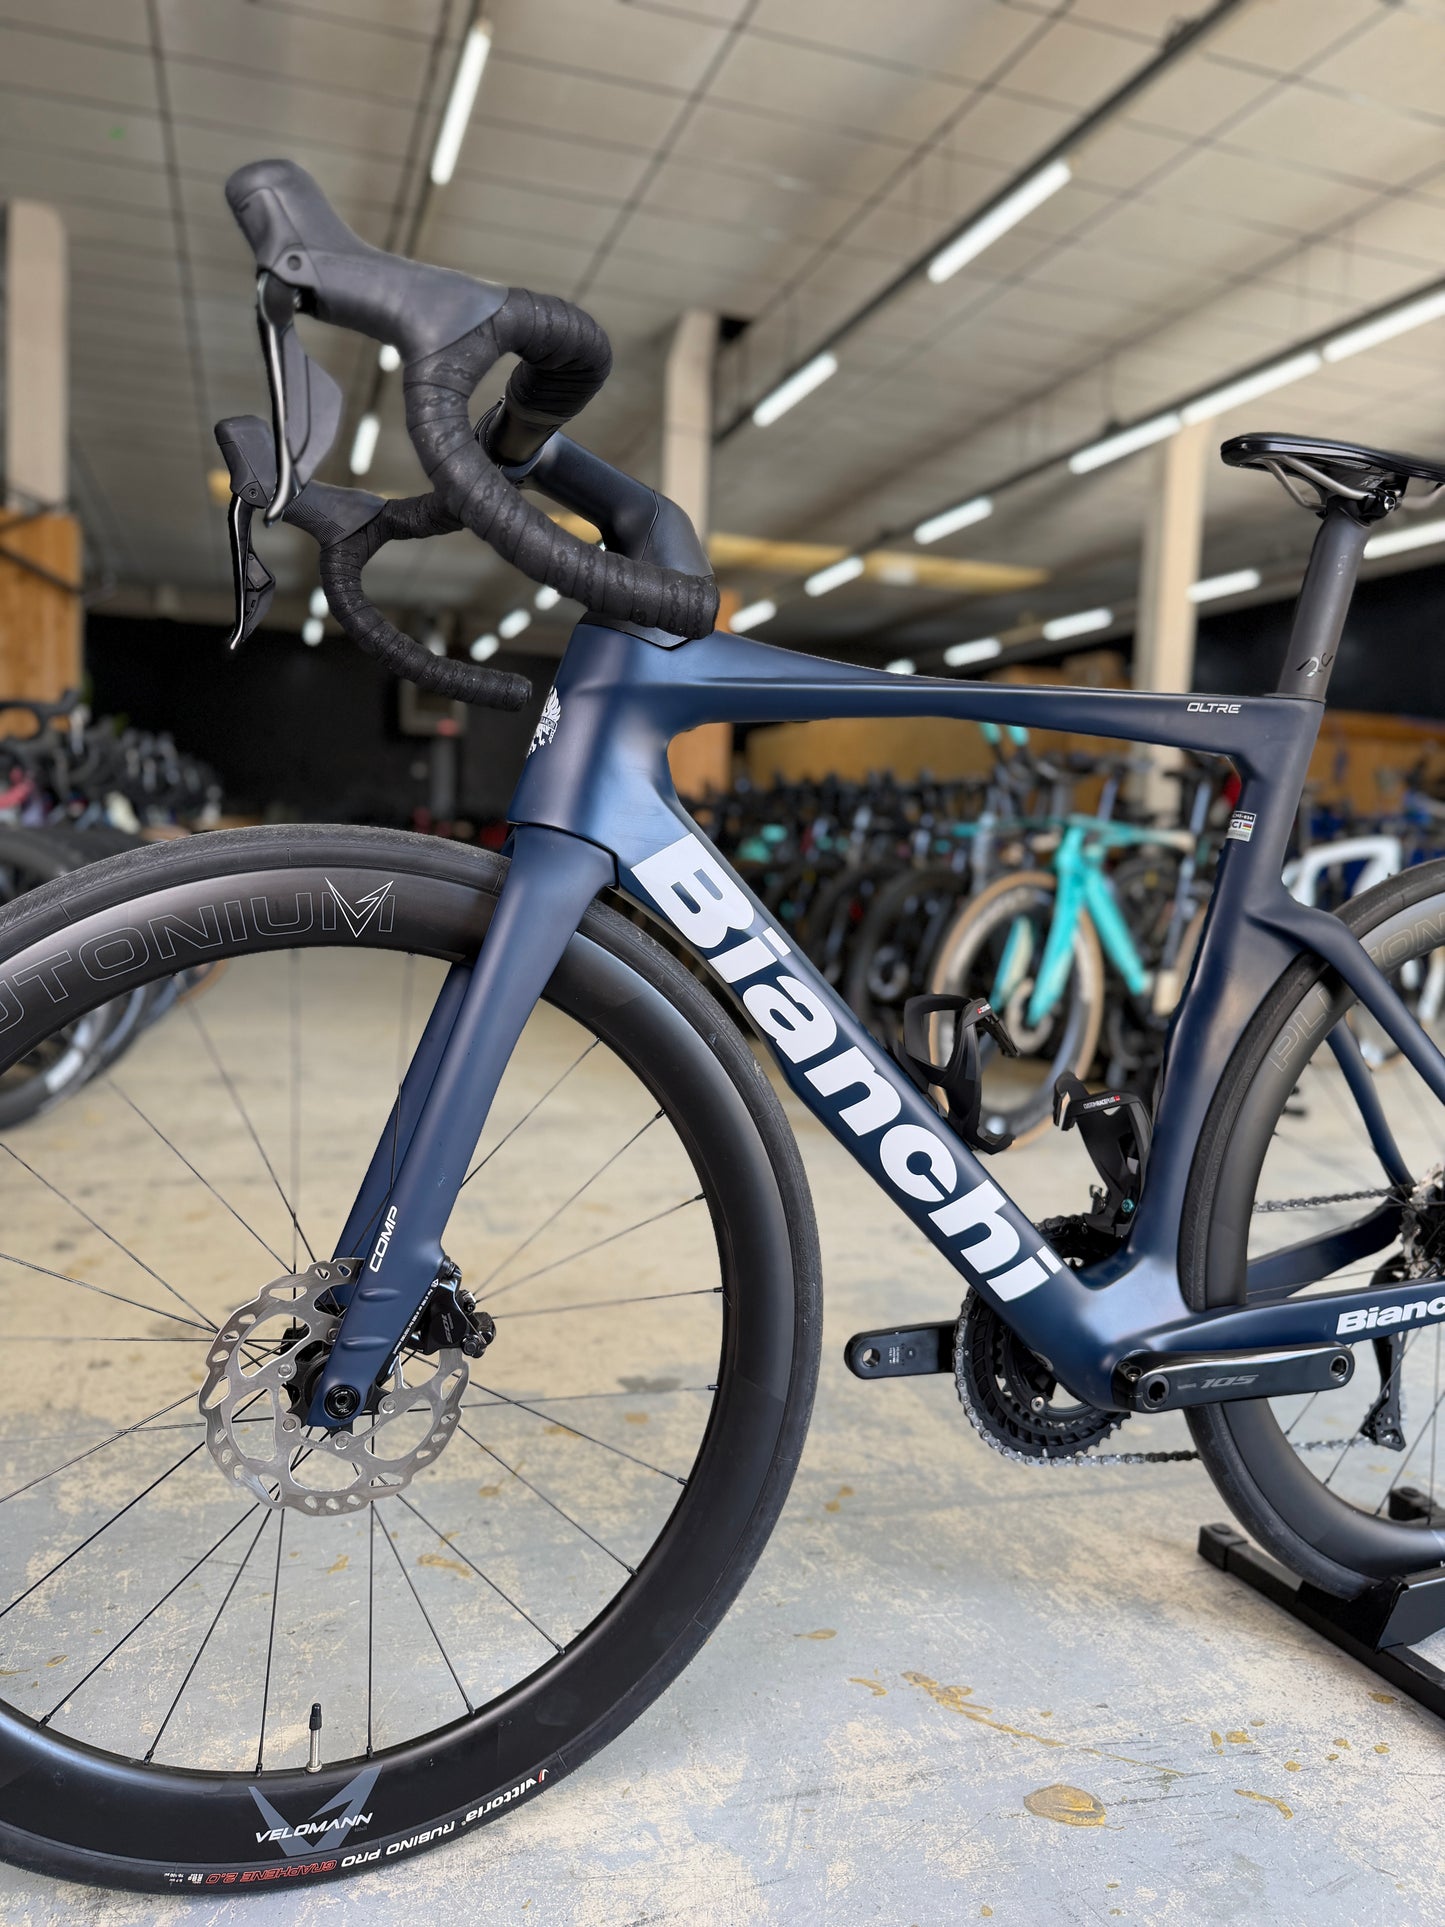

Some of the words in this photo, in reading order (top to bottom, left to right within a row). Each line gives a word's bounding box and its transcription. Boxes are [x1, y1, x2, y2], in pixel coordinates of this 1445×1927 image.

[1187, 702, 1242, 714] OLTRE
[631, 833, 1063, 1302] Bianchi
[369, 1205, 398, 1273] COMP
[1200, 1374, 1259, 1389] 105
[255, 1811, 374, 1844] VELOMANN
[386, 1821, 456, 1855] RUBINO
[341, 1848, 382, 1868] PRO
[205, 1870, 237, 1885] 2.0
[239, 1859, 337, 1884] GRAPHENE
